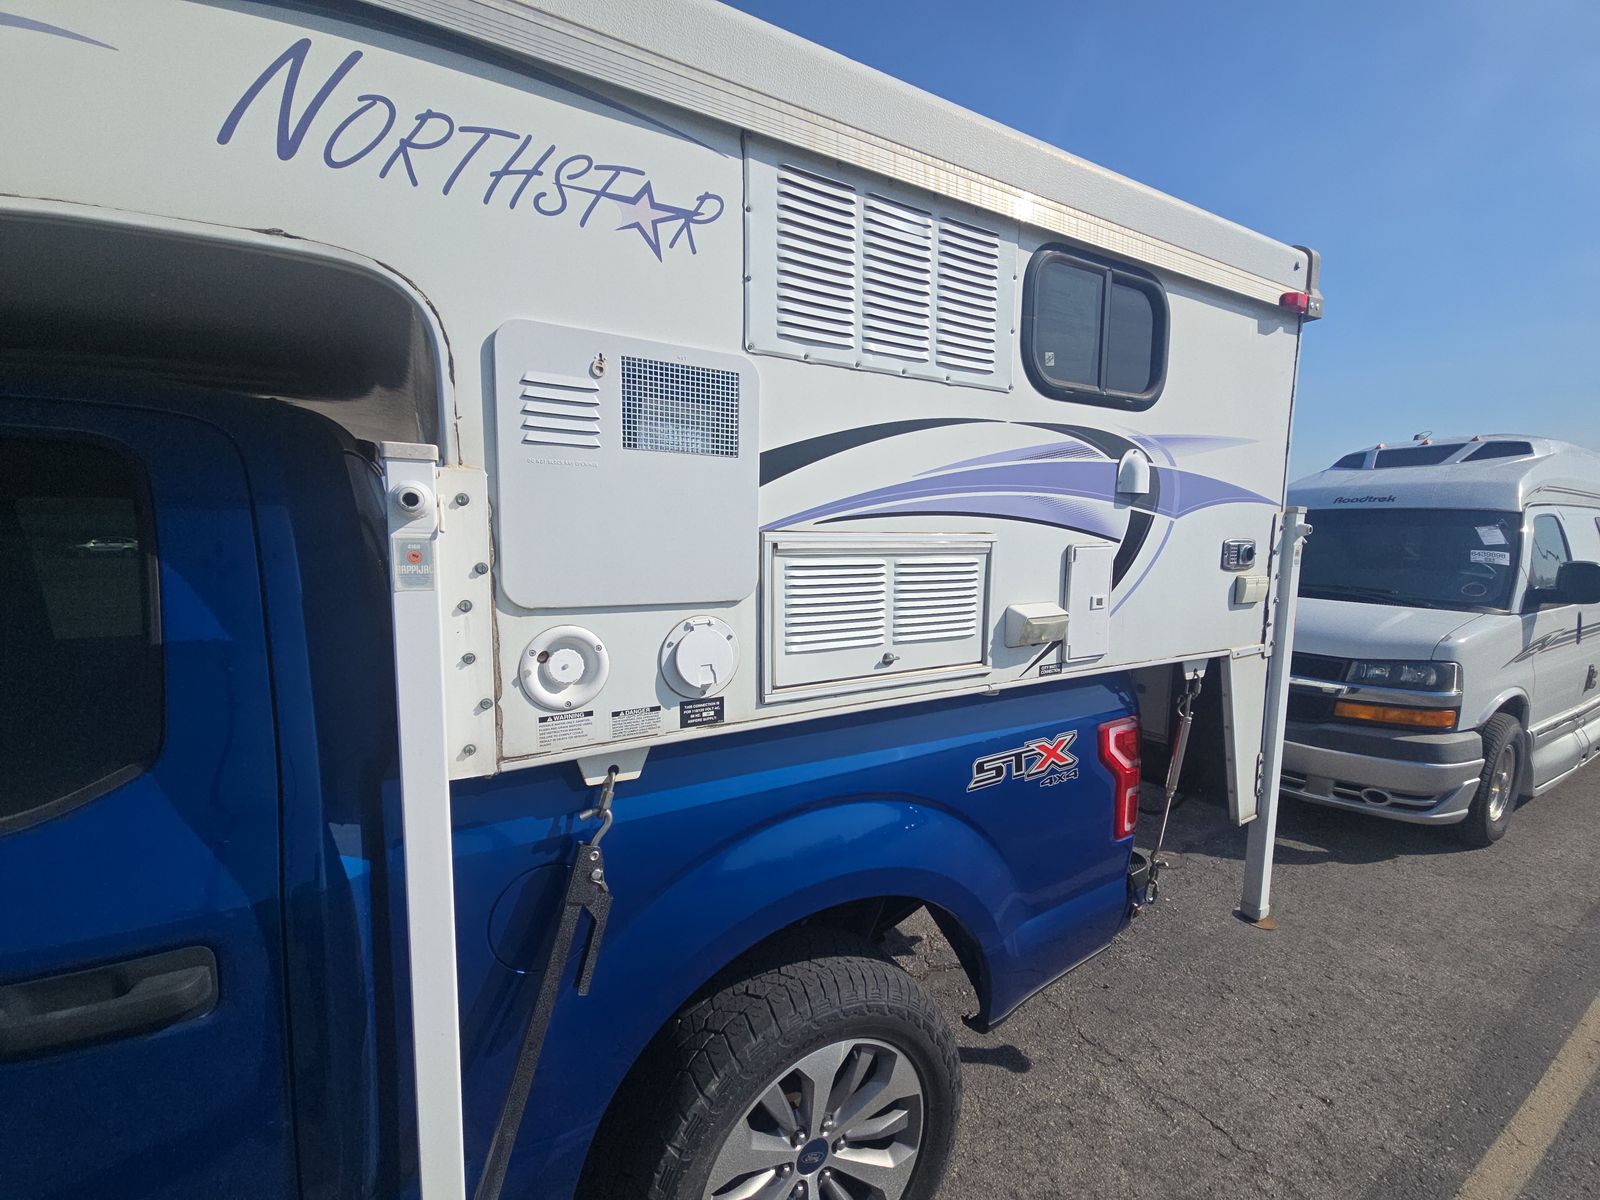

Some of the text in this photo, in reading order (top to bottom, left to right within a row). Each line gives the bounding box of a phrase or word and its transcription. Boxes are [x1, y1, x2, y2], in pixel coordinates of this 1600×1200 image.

[216, 38, 724, 263] NORTHSTAR
[1333, 495, 1397, 504] Roadtrek
[625, 707, 651, 716] DANGER
[554, 712, 585, 721] WARNING
[966, 730, 1079, 792] STX
